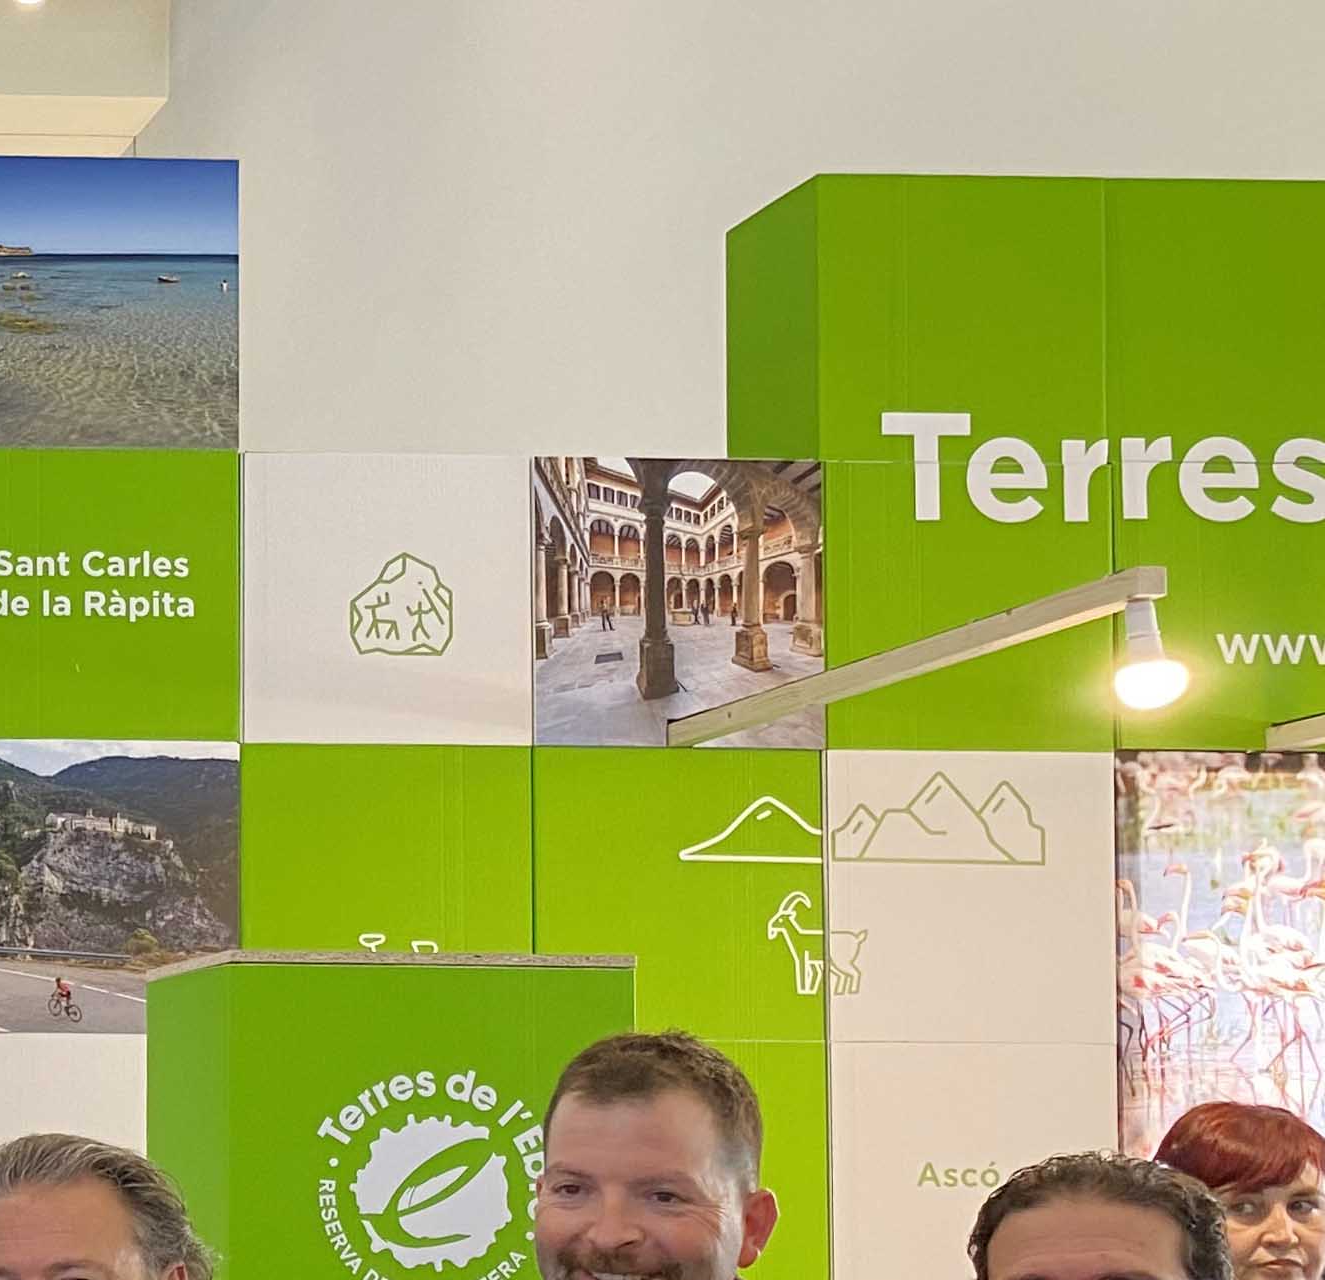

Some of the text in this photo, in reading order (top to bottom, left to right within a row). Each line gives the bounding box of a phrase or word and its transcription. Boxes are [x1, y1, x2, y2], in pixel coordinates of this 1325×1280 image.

[881, 411, 1325, 523] Terres
[82, 550, 189, 578] Carles
[42, 589, 72, 617] la
[84, 589, 195, 623] Ràpita
[316, 1069, 438, 1147] Terres
[444, 1069, 499, 1113] de
[916, 1160, 1001, 1188] Ascó
[317, 1178, 364, 1276] RESERVA
